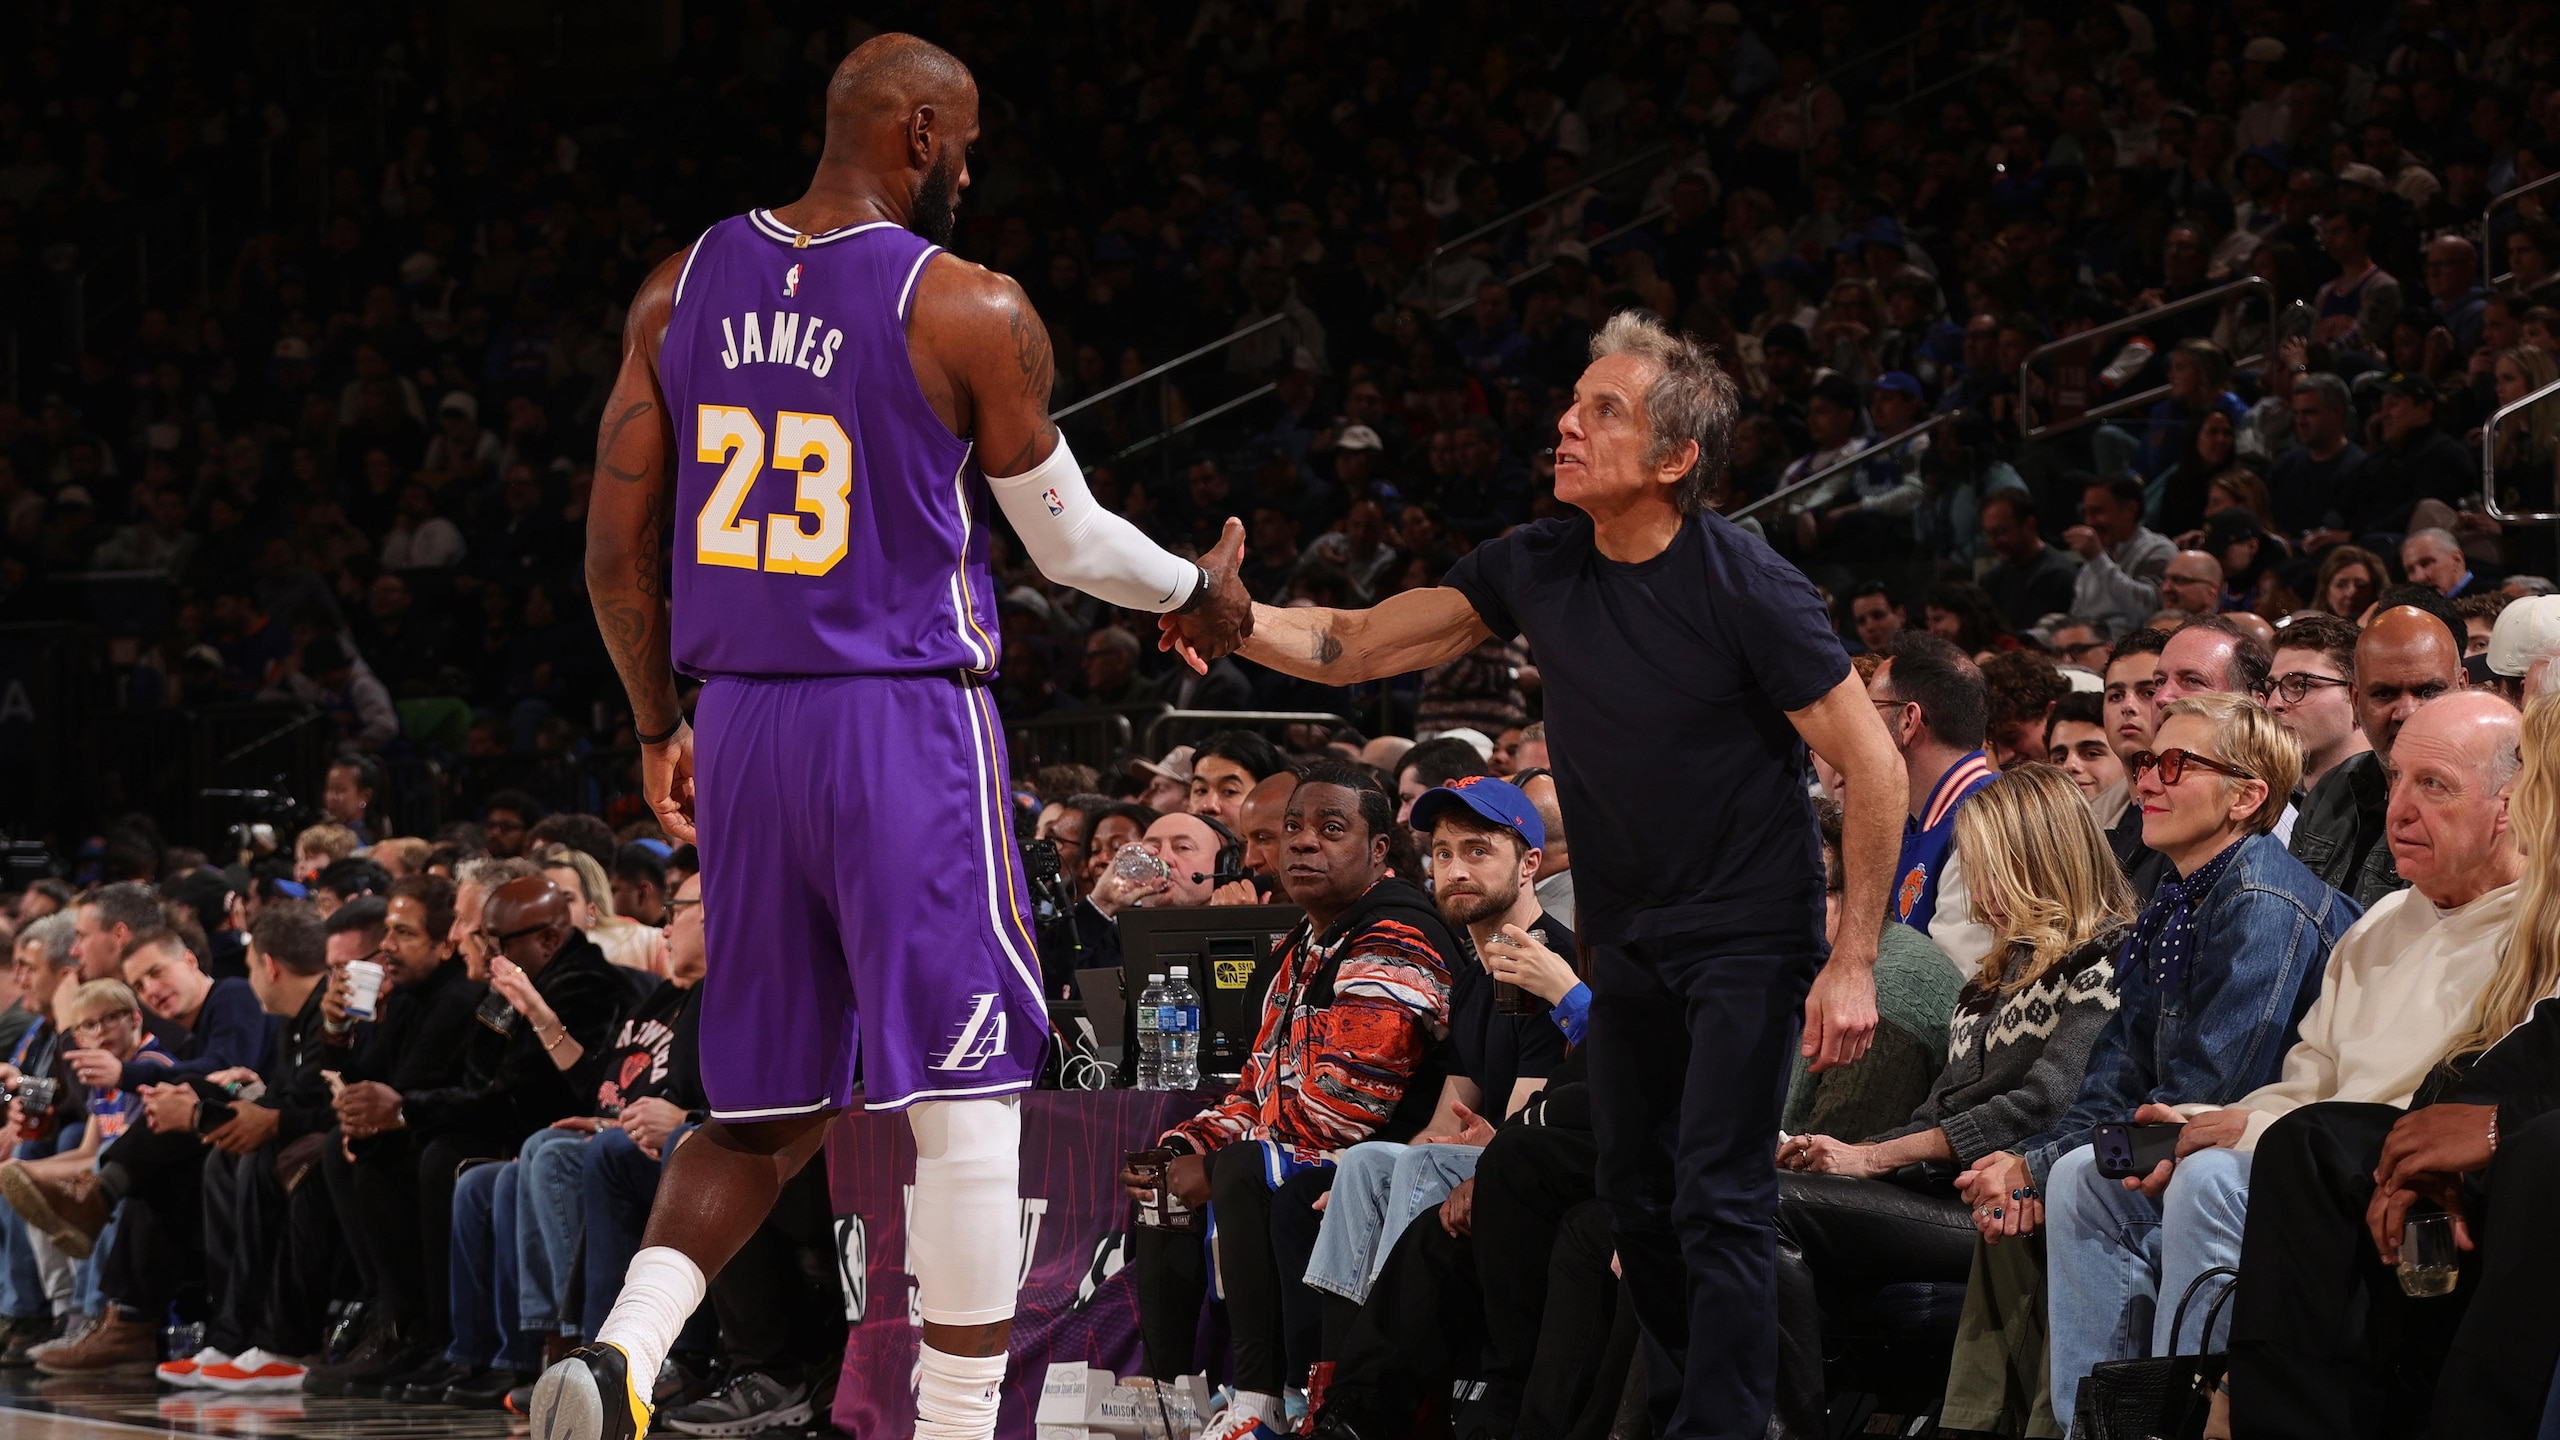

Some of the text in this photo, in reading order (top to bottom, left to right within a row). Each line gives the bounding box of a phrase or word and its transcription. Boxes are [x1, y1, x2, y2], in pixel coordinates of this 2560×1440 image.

[721, 311, 844, 378] JAMES
[697, 404, 852, 577] 23
[1229, 972, 1247, 983] NE
[1101, 1403, 1136, 1417] MADISON
